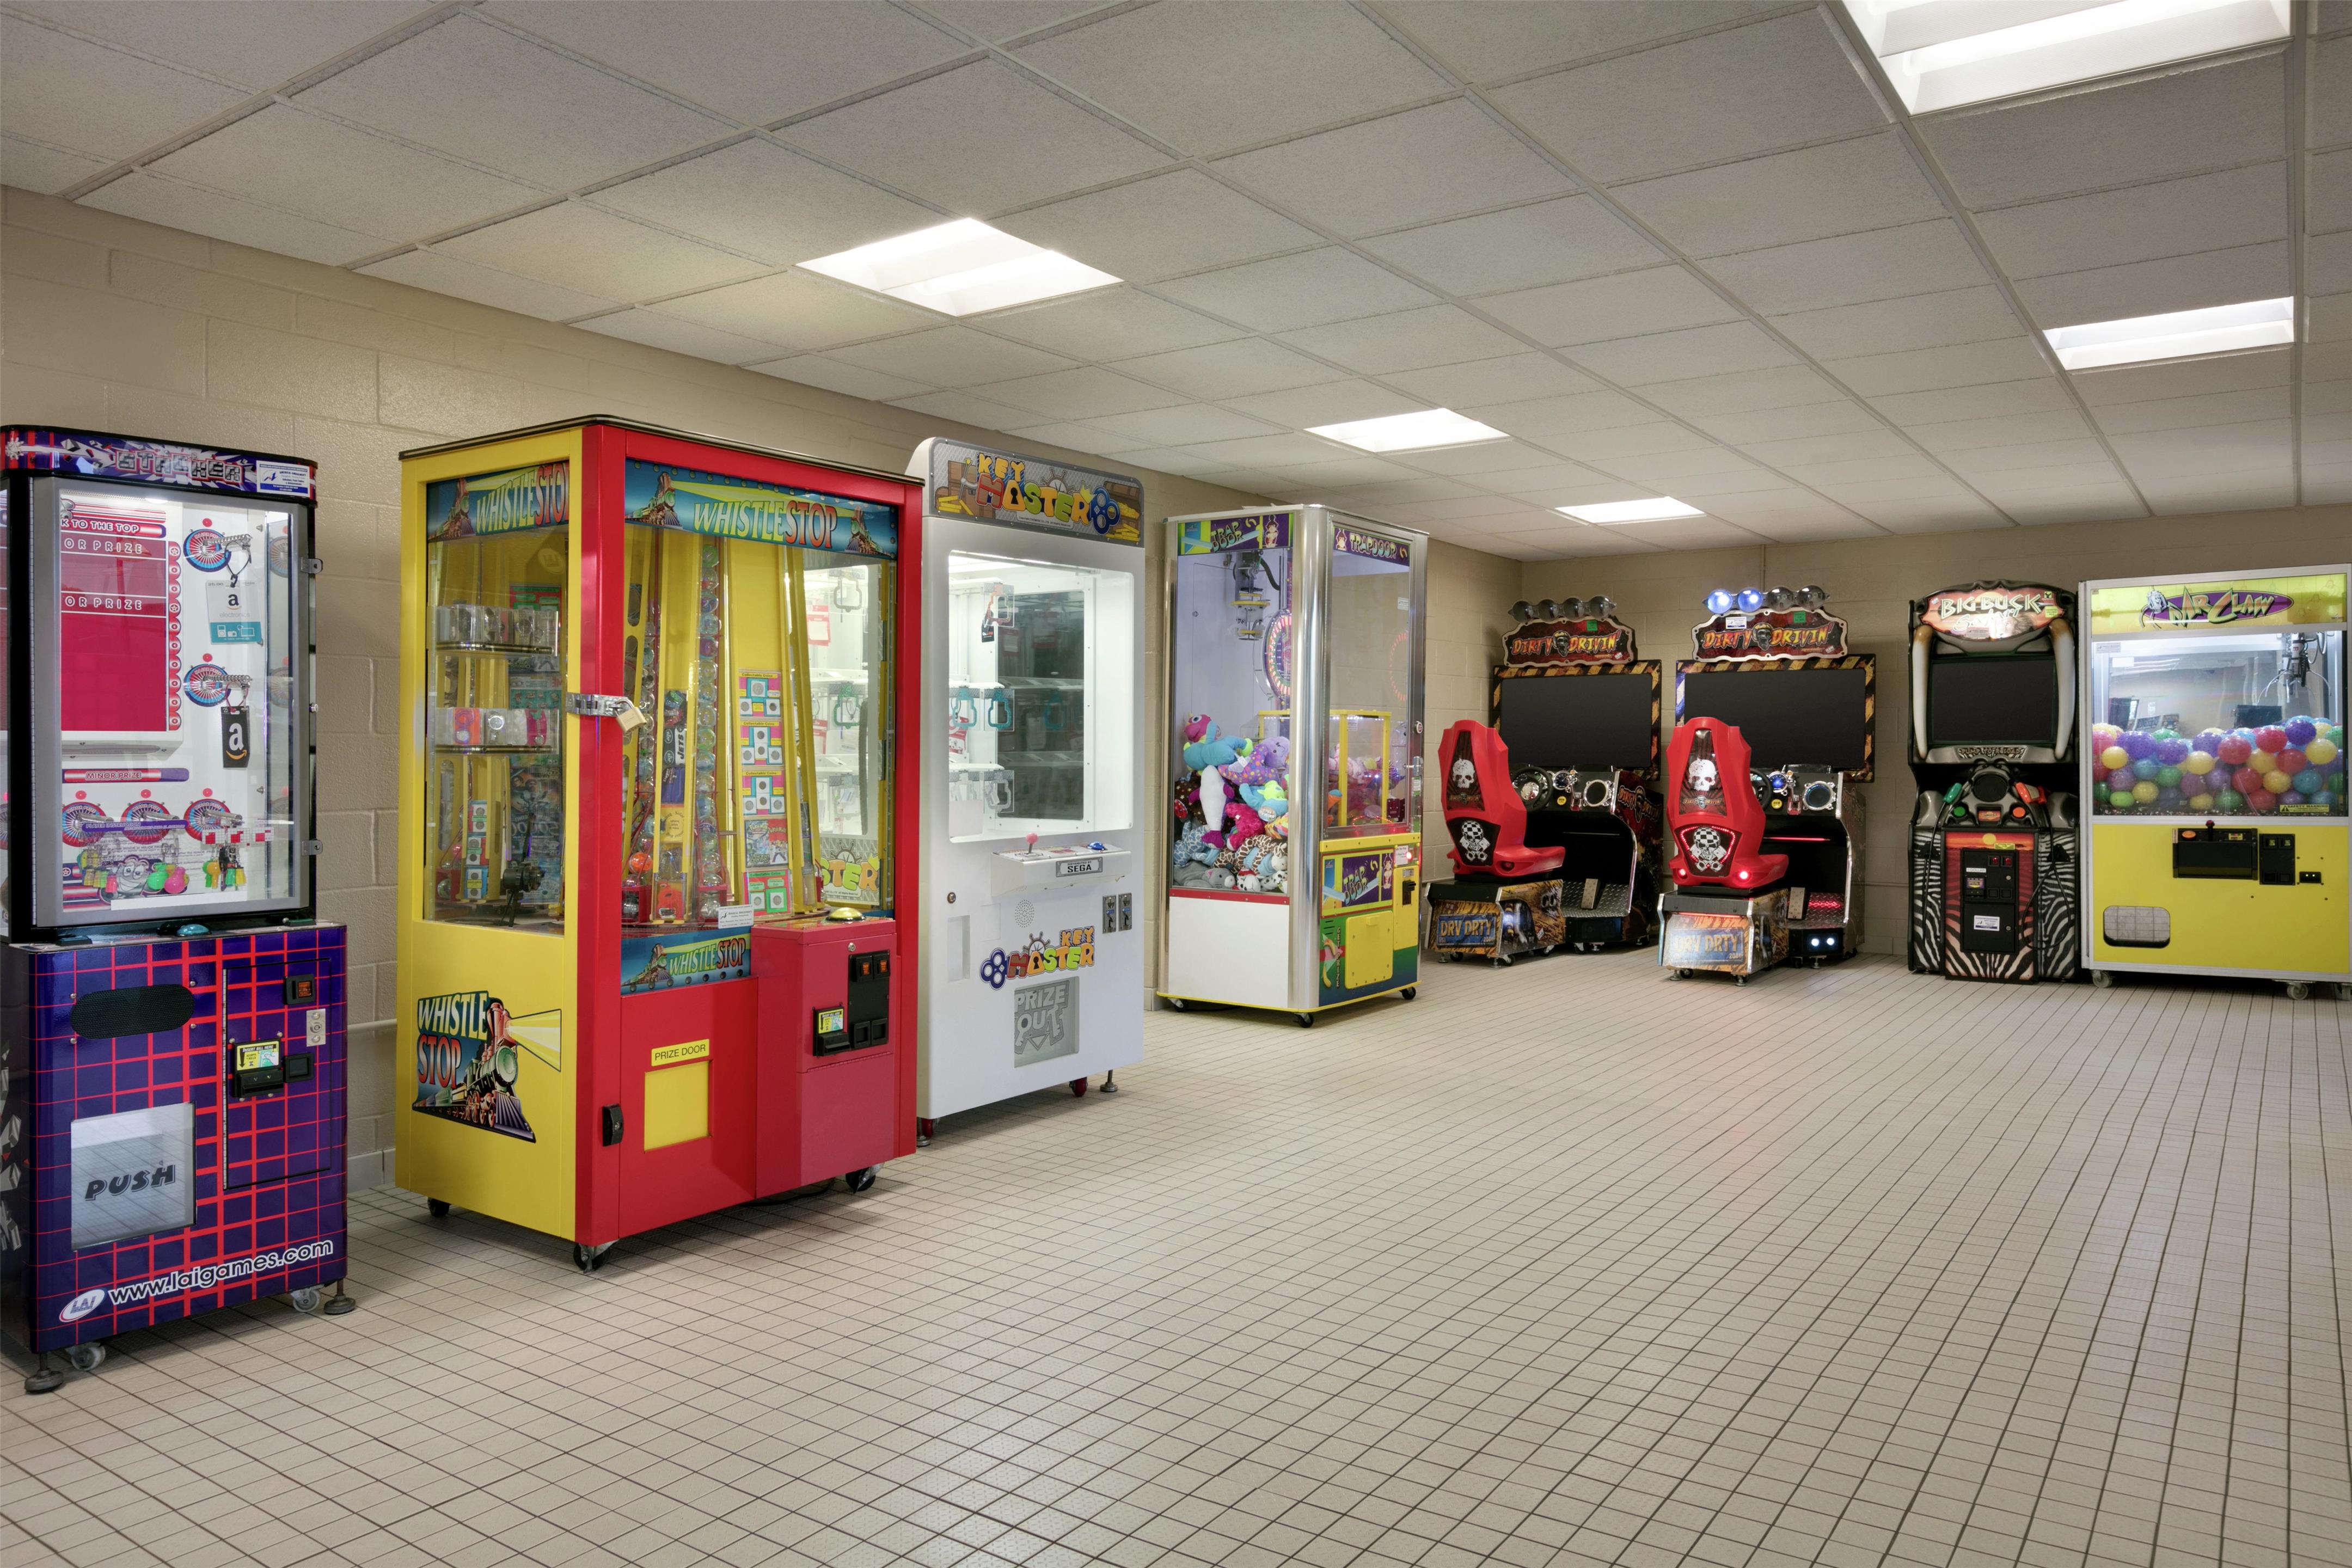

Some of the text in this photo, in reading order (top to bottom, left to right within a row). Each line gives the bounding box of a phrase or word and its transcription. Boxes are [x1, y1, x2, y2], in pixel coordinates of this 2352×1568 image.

[115, 450, 244, 485] STACKER
[978, 453, 1025, 482] KEY
[476, 463, 569, 535] WHISTLE STO
[975, 473, 1092, 525] MASTER
[72, 519, 87, 528] TO
[91, 522, 113, 531] THE
[116, 524, 140, 533] TOP
[693, 500, 837, 549] WHISTLE STOP
[1211, 521, 1241, 540] TRAP
[64, 538, 142, 554] OR PRIZE
[1211, 530, 1244, 552] DOOR
[65, 596, 142, 610] OR PRIZE
[1941, 597, 1976, 620] BIG
[1980, 593, 2041, 614] BUCK
[2207, 587, 2275, 624] CLAW
[1511, 629, 1622, 656] DIRTY DRIVIN'
[1702, 629, 1753, 650] DIRTY
[1769, 622, 1835, 647] DRIVIN'
[229, 722, 243, 751] a
[85, 771, 118, 780] MINOR
[1068, 864, 1092, 873] SEGA
[1344, 866, 1366, 890] TRAP
[1344, 877, 1368, 906] DOOR
[1061, 926, 1094, 946] KEY
[1441, 920, 1491, 936] DRV DRTY
[669, 937, 746, 977] WHISTLE STOP
[1705, 934, 1738, 952] DRTY
[1007, 942, 1094, 979] MASTER
[1014, 984, 1067, 1012] PRIZE
[418, 993, 489, 1042] WHISTLE
[1015, 1004, 1061, 1047] OUT
[418, 1034, 461, 1088] STOP
[654, 1045, 706, 1061] PRIZE DOOR
[85, 1163, 176, 1200] PUSH
[108, 1239, 334, 1306] www.laigames.com
